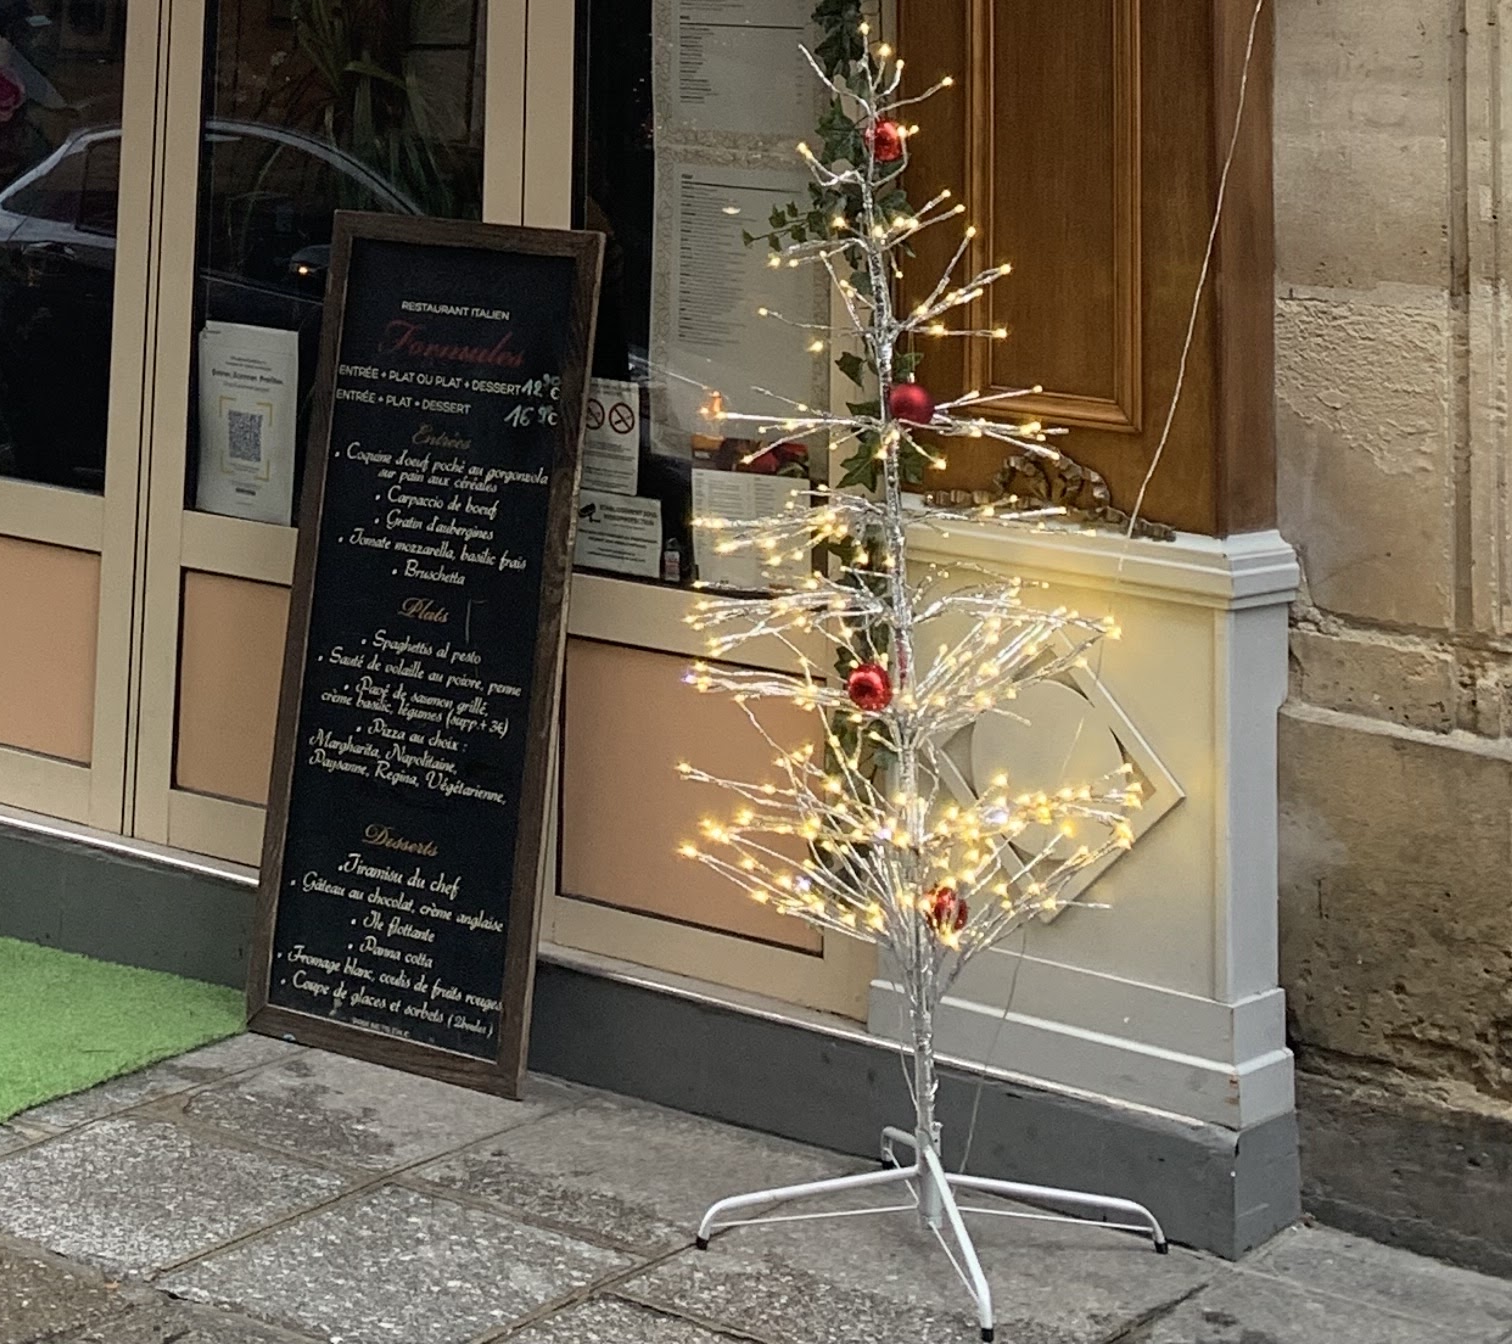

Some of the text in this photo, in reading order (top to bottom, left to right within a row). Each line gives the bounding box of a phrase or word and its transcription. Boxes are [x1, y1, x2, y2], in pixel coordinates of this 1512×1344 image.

[401, 300, 511, 321] RESTAURANT ITALIEN
[339, 364, 380, 380] ENTRÉE
[388, 370, 416, 383] PLAT
[416, 373, 434, 386] OU
[435, 375, 463, 389] PLAT
[471, 379, 522, 396] DESSERT
[336, 388, 377, 404] ENTRÉE
[385, 394, 413, 408] PLAT
[422, 398, 472, 415] DESSERT
[398, 469, 426, 484] pain
[427, 475, 451, 487] aux
[431, 457, 466, 474] poché
[468, 466, 484, 477] au
[387, 484, 445, 510] Carpaccio
[447, 494, 462, 512] de
[386, 508, 424, 531] Gratin
[459, 543, 497, 566] basilic
[498, 549, 527, 572] frais
[404, 558, 466, 586] Bruschetta
[397, 597, 450, 624] Plats
[372, 629, 482, 665] Spaghettis al pesto
[329, 645, 366, 669] Sauté
[366, 653, 382, 672] de
[384, 658, 425, 680] volaille
[427, 672, 444, 683] au
[487, 682, 522, 697] penne
[321, 688, 354, 706] crème
[392, 682, 408, 703] de
[367, 717, 407, 741] Pizza
[408, 733, 425, 745] au
[428, 729, 459, 752] choix
[361, 824, 439, 857] Desserts
[343, 852, 462, 901] Tiramisu du chef
[302, 871, 346, 897] Gâteau
[348, 889, 365, 901] au
[419, 902, 453, 921] crème
[455, 910, 504, 933] anglaise
[386, 917, 436, 943] flottante
[359, 935, 434, 969] Panna cotta
[287, 944, 342, 975] Fromage
[378, 969, 411, 989] coulis
[413, 974, 429, 994] de
[430, 978, 463, 1002] fruits
[465, 994, 504, 1014] rouges
[292, 969, 331, 997] Coupe
[332, 980, 348, 1000] de
[350, 985, 387, 1009] glaces
[389, 1000, 402, 1013] et
[403, 1001, 444, 1024] sorbets
